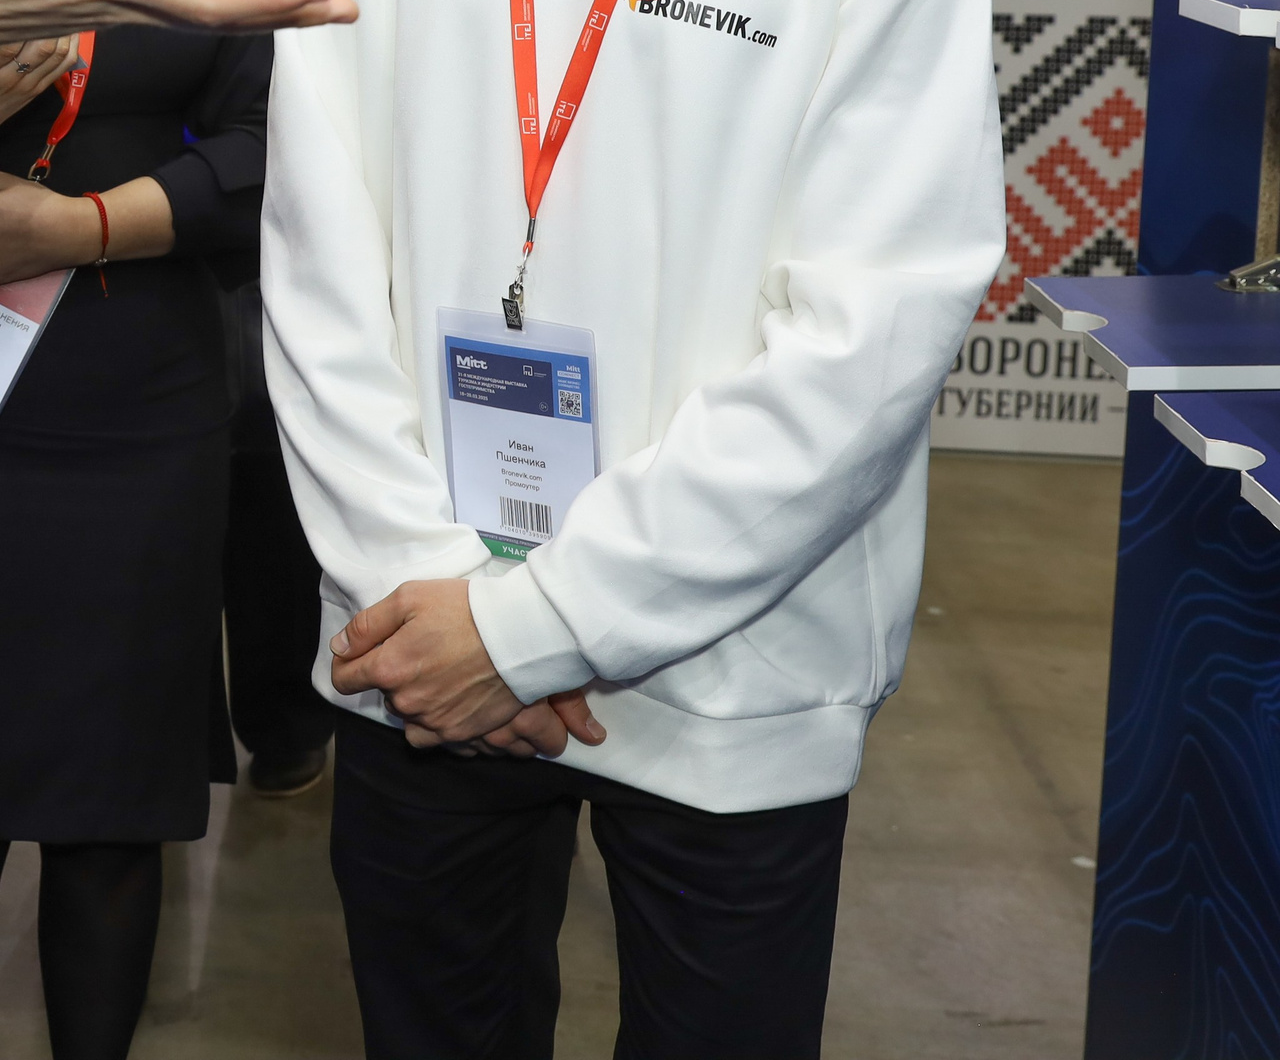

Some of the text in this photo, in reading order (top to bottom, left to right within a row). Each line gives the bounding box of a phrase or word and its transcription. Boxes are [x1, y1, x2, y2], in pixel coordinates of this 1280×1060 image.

[456, 355, 488, 370] Mitt
[937, 386, 1100, 423] ГУБЕРНИИ
[508, 439, 534, 452] Иван
[496, 451, 546, 469] Пшенчика
[501, 468, 543, 481] Bronevik.com
[504, 478, 540, 492] Промоутер
